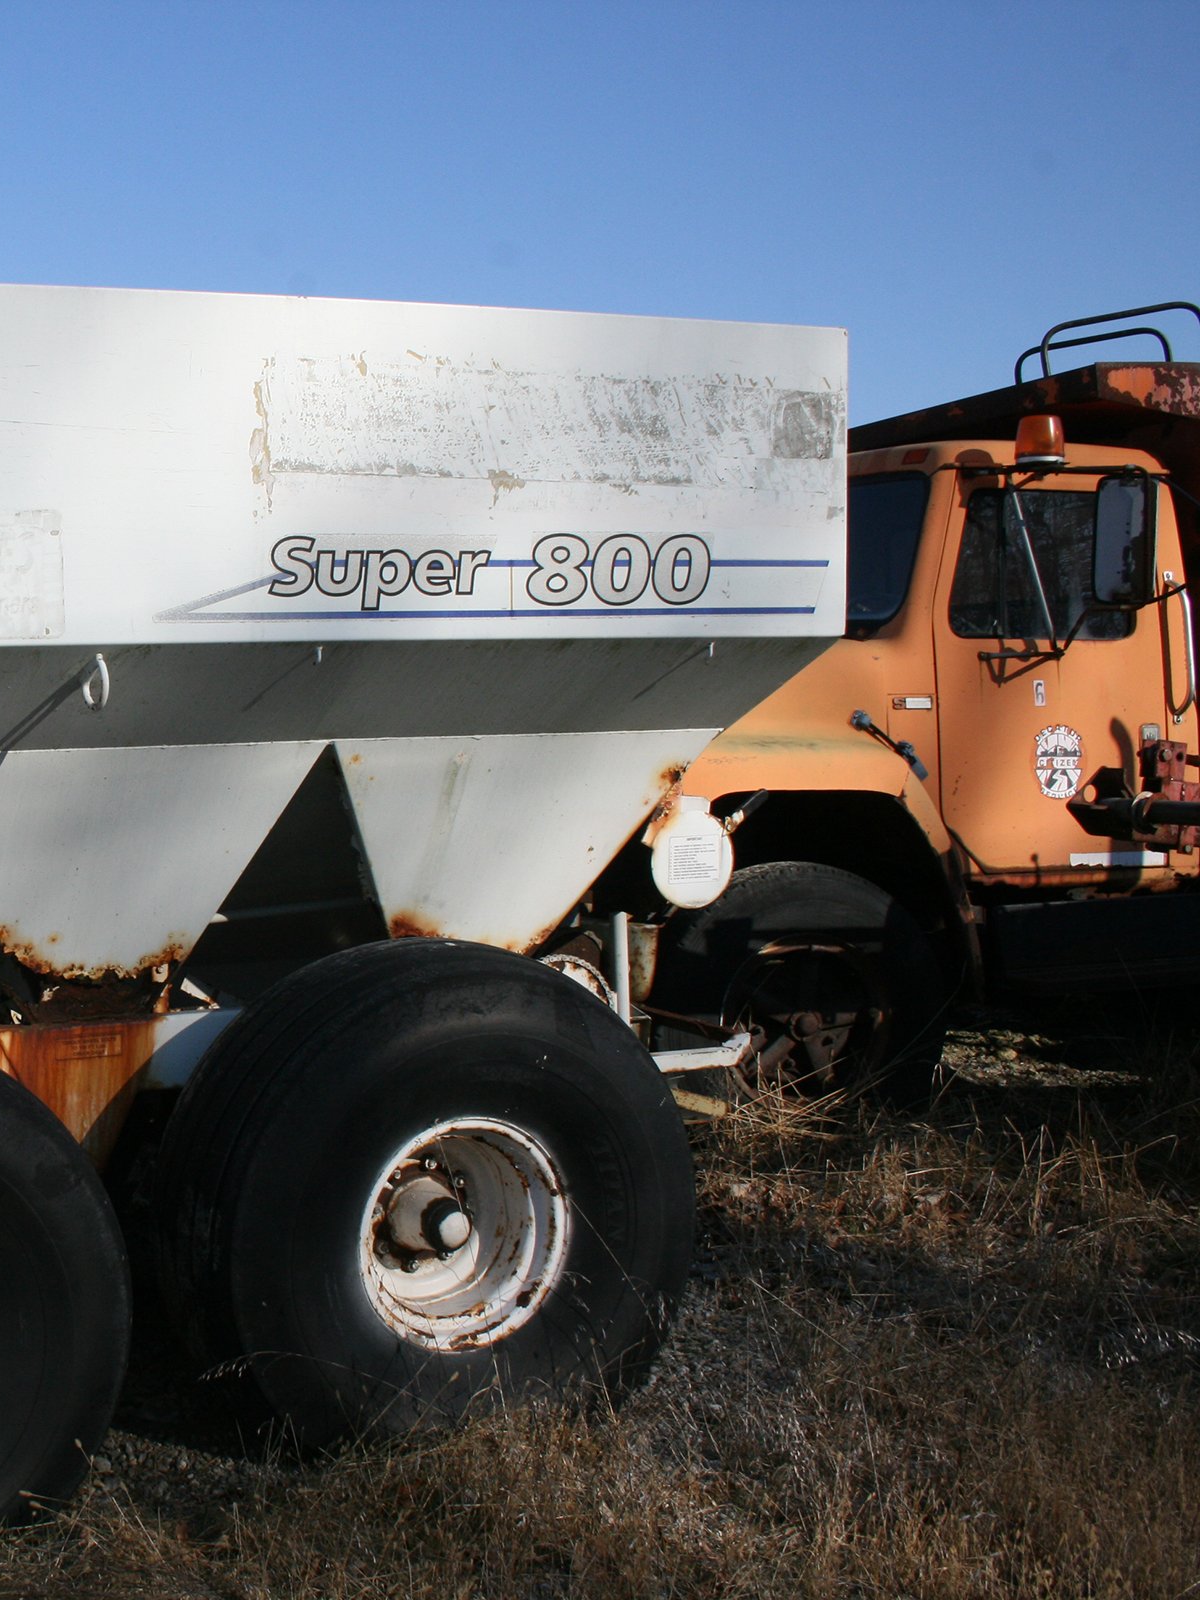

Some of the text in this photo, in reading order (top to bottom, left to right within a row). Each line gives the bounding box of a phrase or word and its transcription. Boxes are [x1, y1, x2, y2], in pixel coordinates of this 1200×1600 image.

[267, 533, 711, 610] Super 800
[1039, 759, 1078, 768] CIZEN
